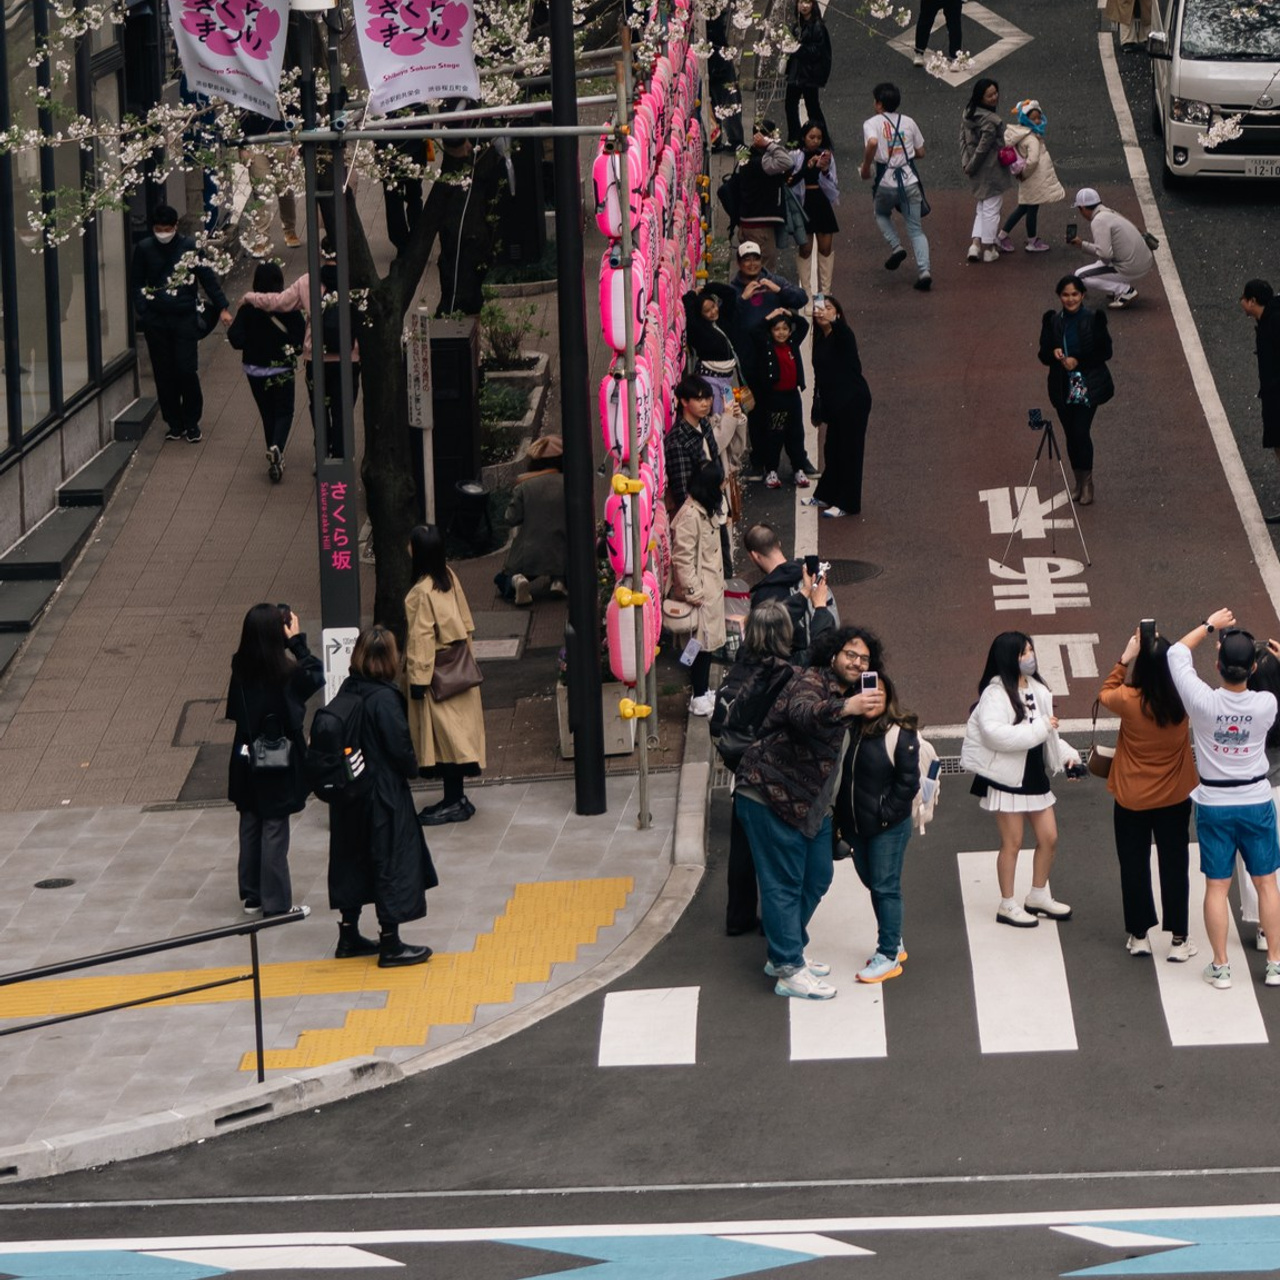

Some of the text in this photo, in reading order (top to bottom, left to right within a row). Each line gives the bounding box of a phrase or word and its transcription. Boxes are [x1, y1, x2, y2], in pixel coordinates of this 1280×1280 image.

[195, 19, 262, 51] まつり
[381, 23, 450, 48] まつり
[410, 64, 437, 73] Sakura
[437, 62, 460, 70] Stage
[320, 482, 331, 550] Sakura-zaka Hill
[330, 481, 352, 570] さくら坂
[1216, 714, 1253, 723] KYOTO
[1213, 744, 1250, 754] 2024
